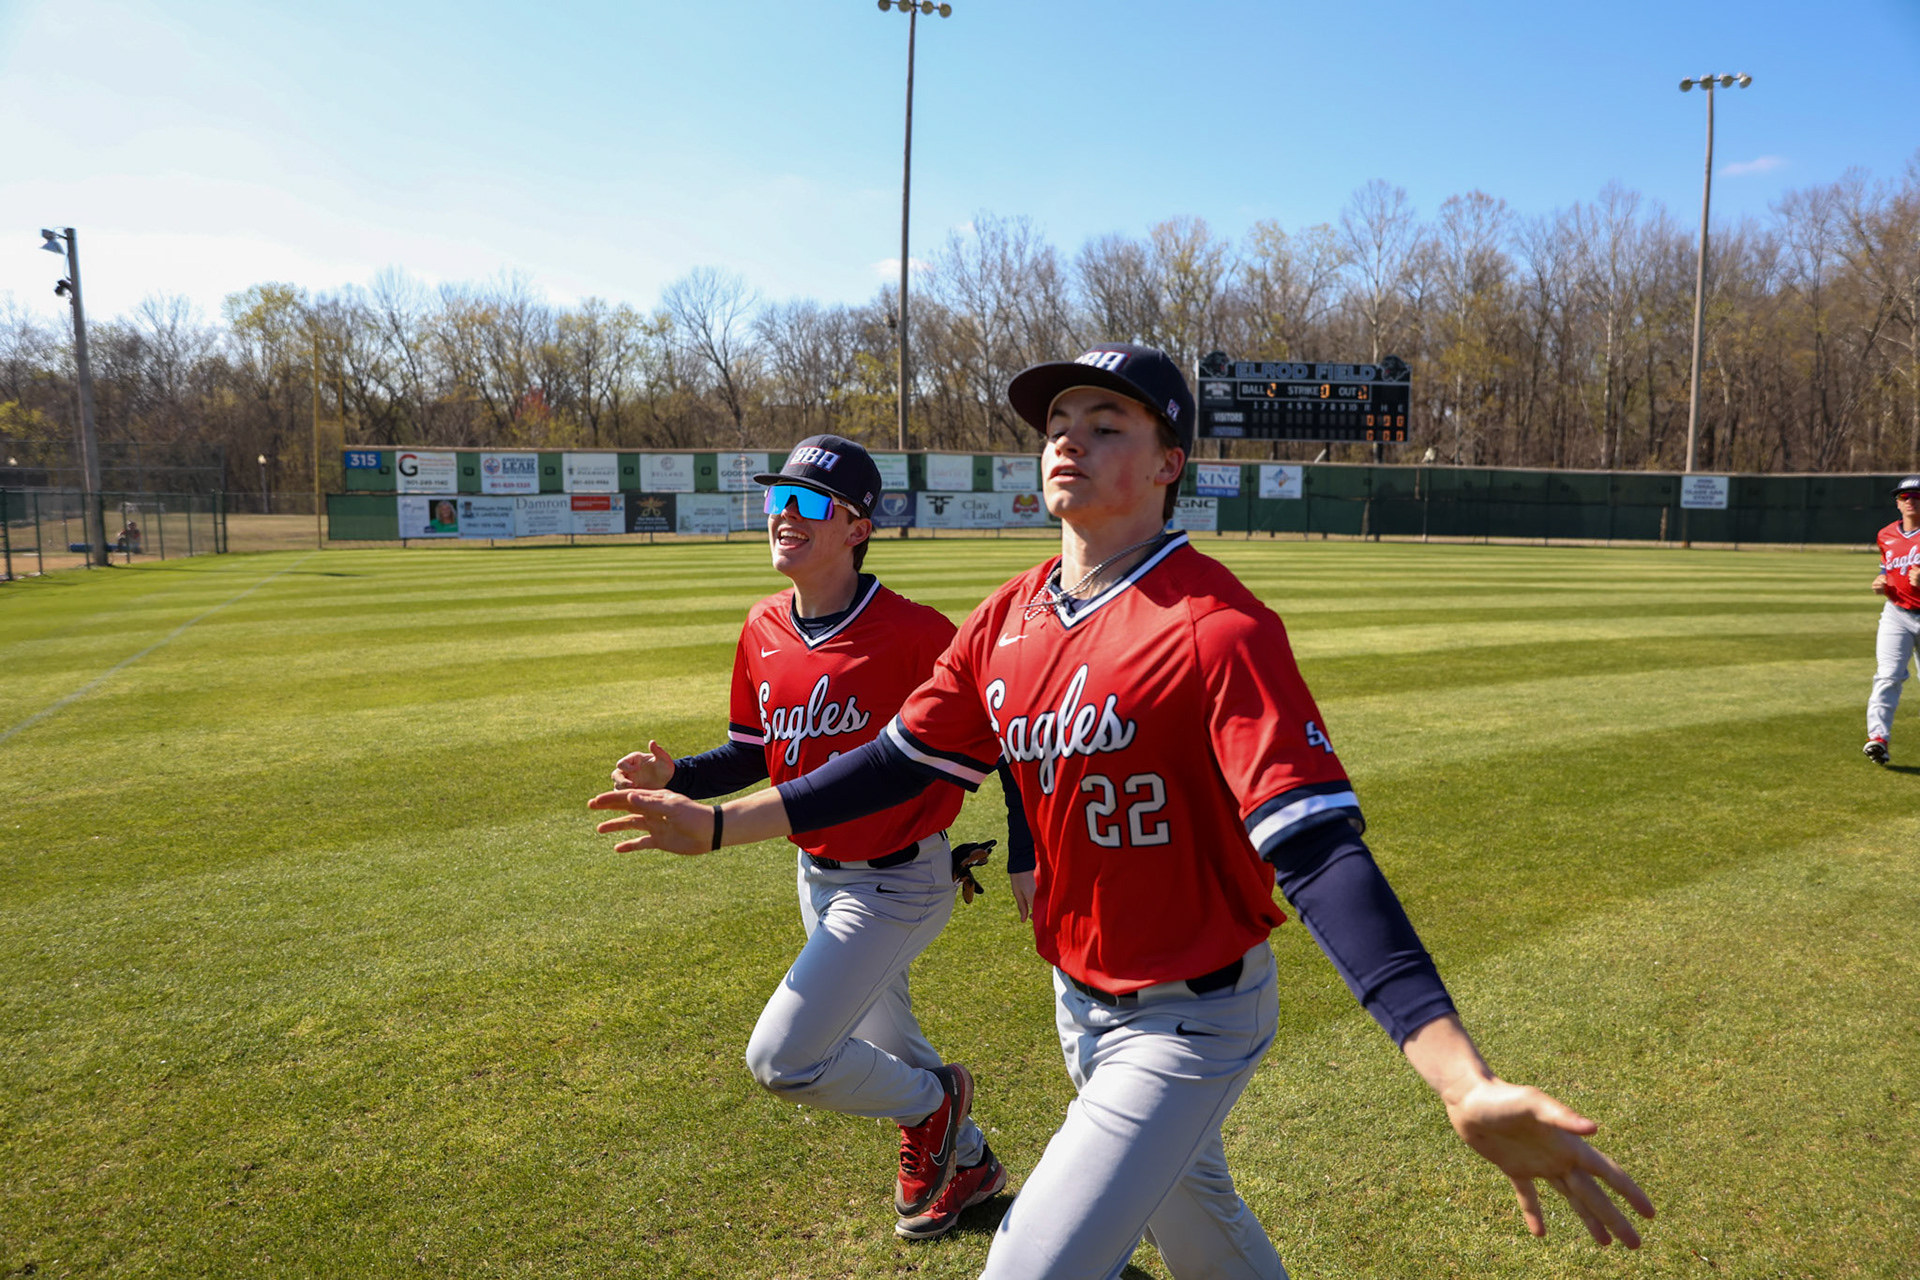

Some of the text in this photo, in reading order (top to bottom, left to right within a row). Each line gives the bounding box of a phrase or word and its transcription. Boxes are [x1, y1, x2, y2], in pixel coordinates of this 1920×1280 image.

[1235, 363, 1376, 381] ELROD FIELD
[1242, 385, 1265, 395] BALL
[1287, 386, 1319, 396] STRIKE
[1338, 387, 1356, 396] OUT
[1214, 412, 1243, 423] VISITORS
[350, 454, 377, 467] 315
[398, 454, 418, 477] G
[790, 447, 841, 472] SBA
[502, 462, 536, 471] LEAK
[1198, 473, 1239, 485] KING
[516, 498, 568, 510] Damron
[962, 500, 990, 511] Clay
[1177, 499, 1217, 508] GNC
[972, 510, 1002, 520] Land
[1885, 545, 1920, 576] Eagle
[758, 673, 872, 767] Eagles
[985, 664, 1138, 796] Eagles
[1080, 773, 1171, 849] 22
